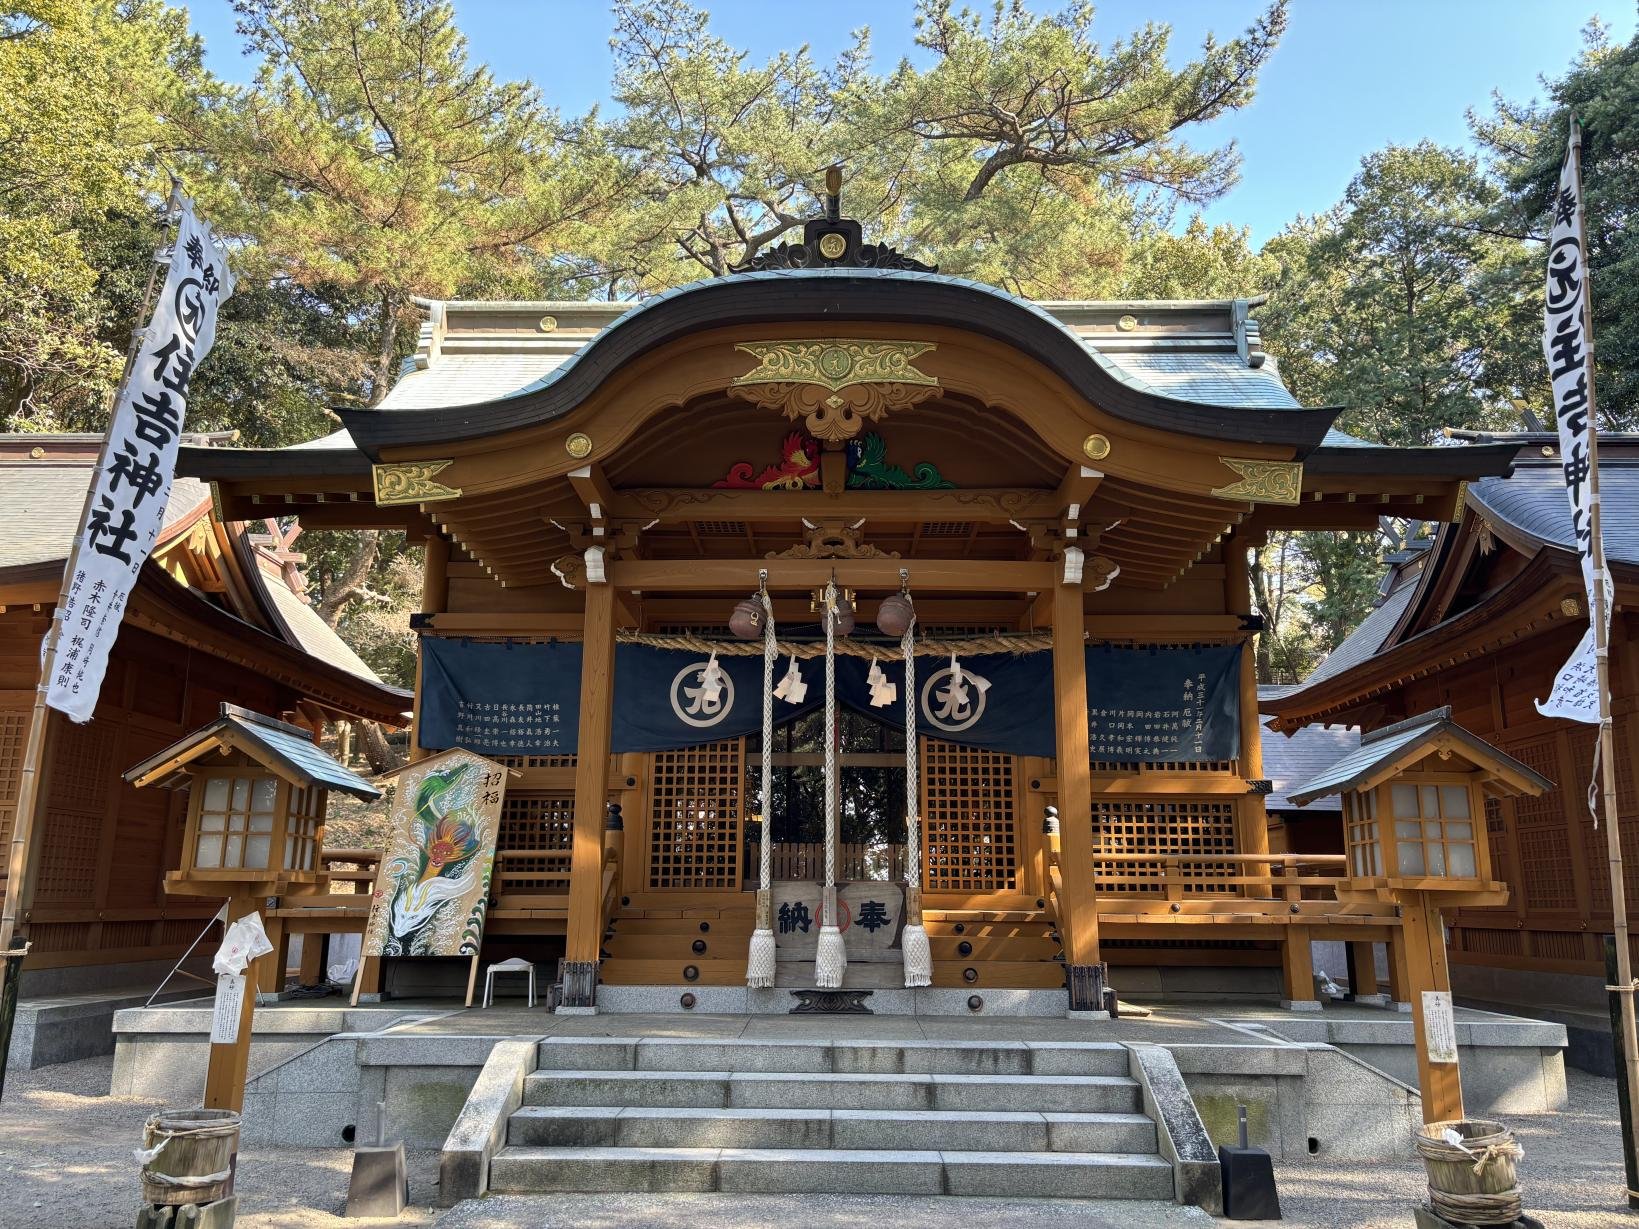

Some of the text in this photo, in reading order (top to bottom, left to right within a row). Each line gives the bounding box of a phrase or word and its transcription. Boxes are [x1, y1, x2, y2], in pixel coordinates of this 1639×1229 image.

[86, 333, 195, 567] 住吉神社
[80, 579, 108, 631] 赤木隆司
[1183, 678, 1194, 702] 奉納
[482, 772, 502, 805] 招福
[778, 902, 812, 934] 納
[854, 900, 891, 933] 奉
